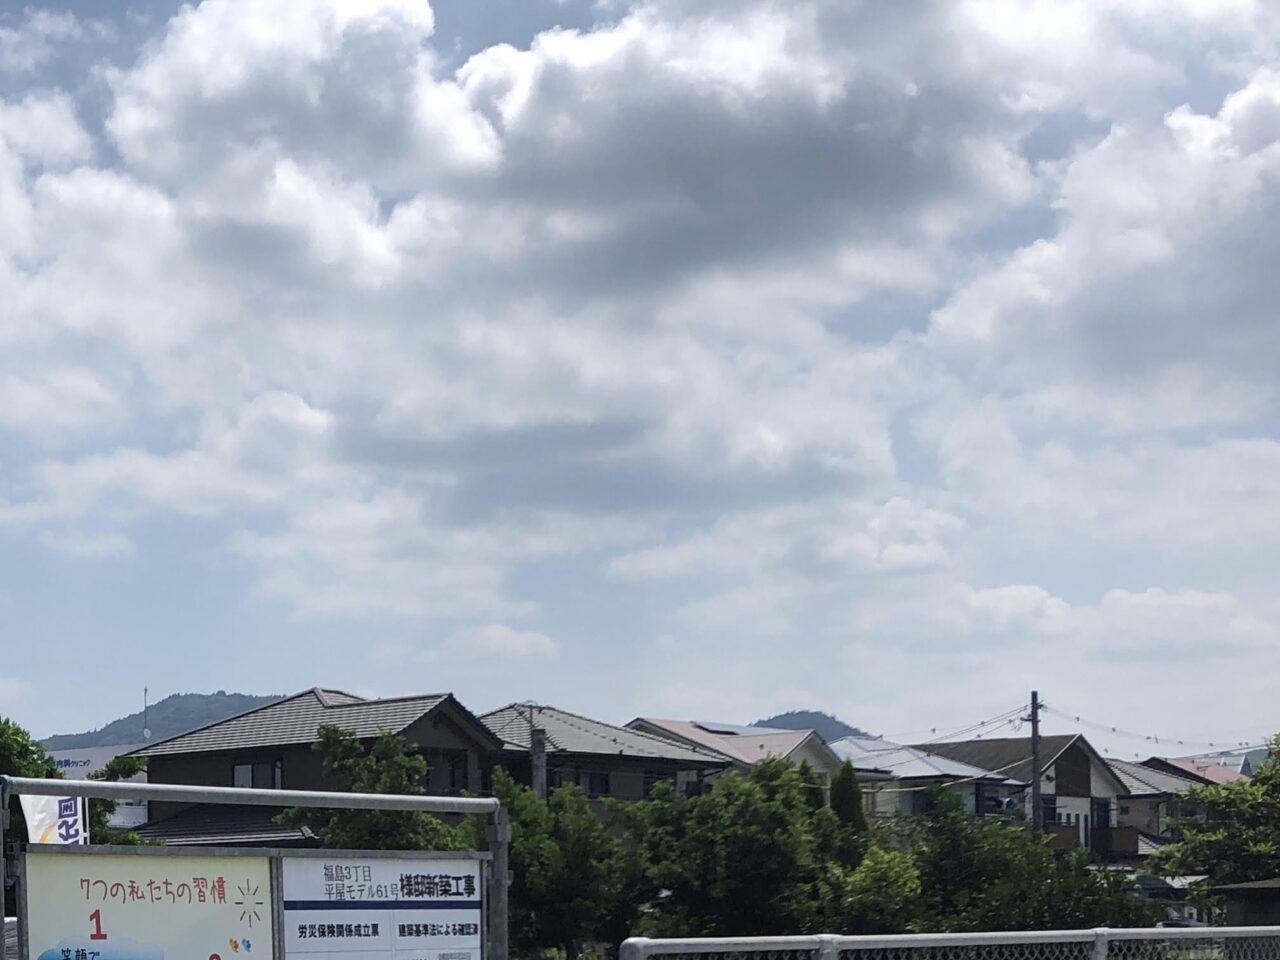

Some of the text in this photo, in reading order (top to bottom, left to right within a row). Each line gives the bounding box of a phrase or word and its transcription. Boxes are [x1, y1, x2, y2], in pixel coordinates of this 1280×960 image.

[323, 864, 372, 882] 福島3丁目
[80, 877, 227, 904] 7つの私たちの習慣
[324, 883, 399, 900] 平屋モデル61号
[399, 874, 476, 898] 様邸新築工事
[89, 909, 107, 940] 1
[298, 923, 380, 938] 労災保険関係成立票
